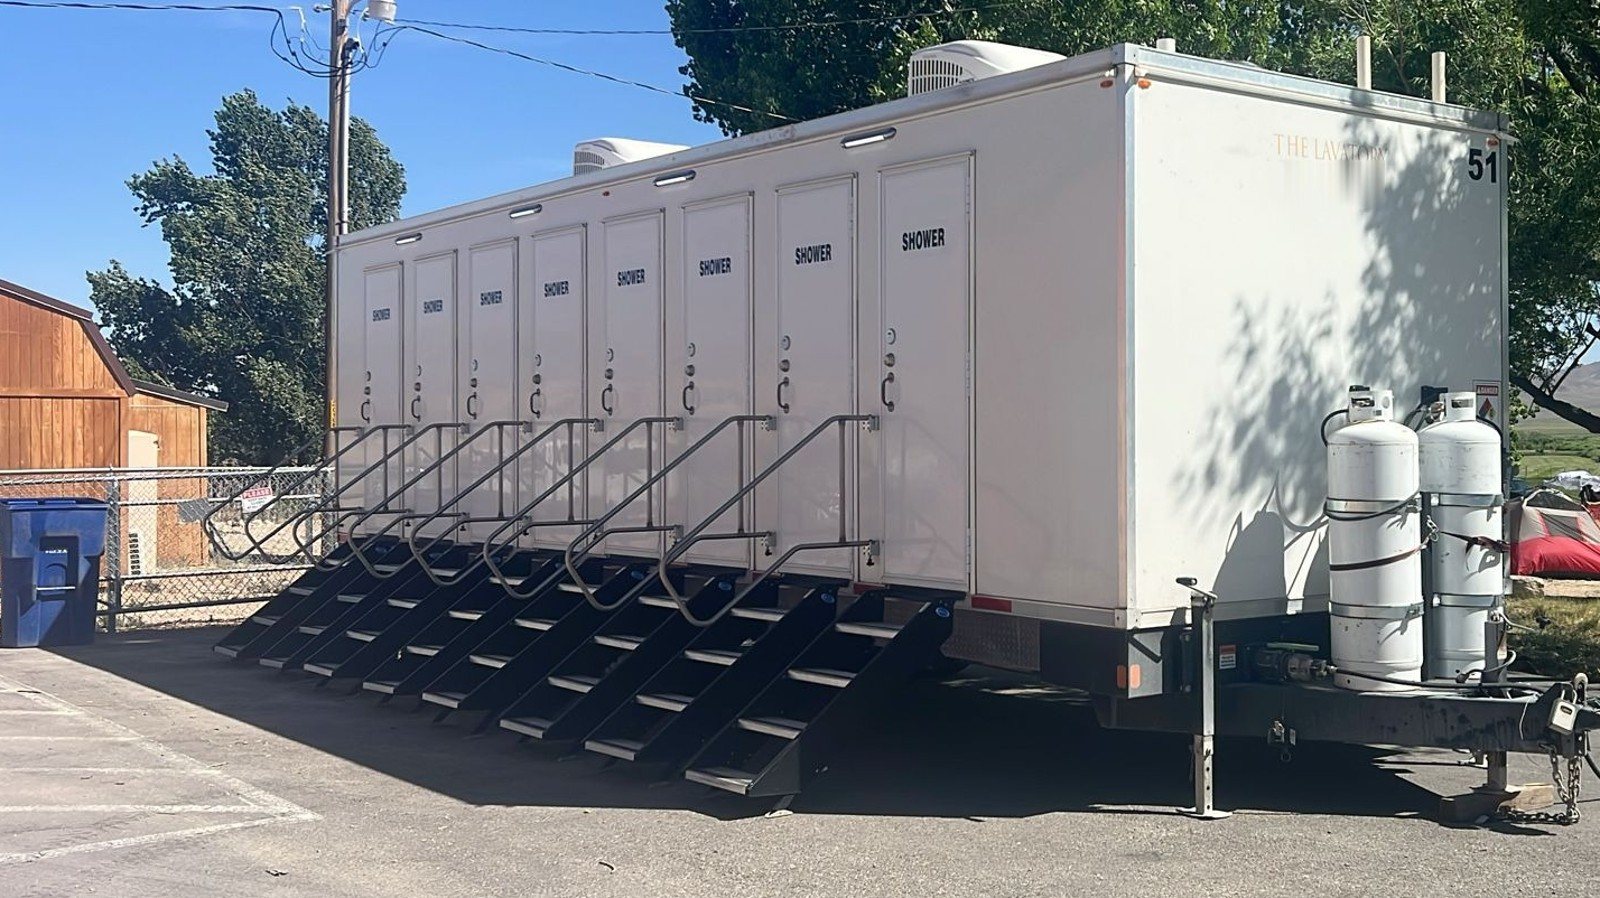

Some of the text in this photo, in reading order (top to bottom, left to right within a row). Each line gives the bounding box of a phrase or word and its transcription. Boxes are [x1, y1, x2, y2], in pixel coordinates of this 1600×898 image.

[1273, 134, 1307, 157] THE
[1468, 148, 1497, 183] 51
[902, 228, 945, 251] SHOWER
[795, 244, 831, 265] SHOWER
[699, 258, 731, 276] SHOWER
[617, 269, 645, 286] SHOWER
[544, 281, 569, 298] SHOWER
[423, 300, 442, 314] SHOWER
[480, 291, 502, 307] SHOWER
[372, 308, 390, 322] SHOWER
